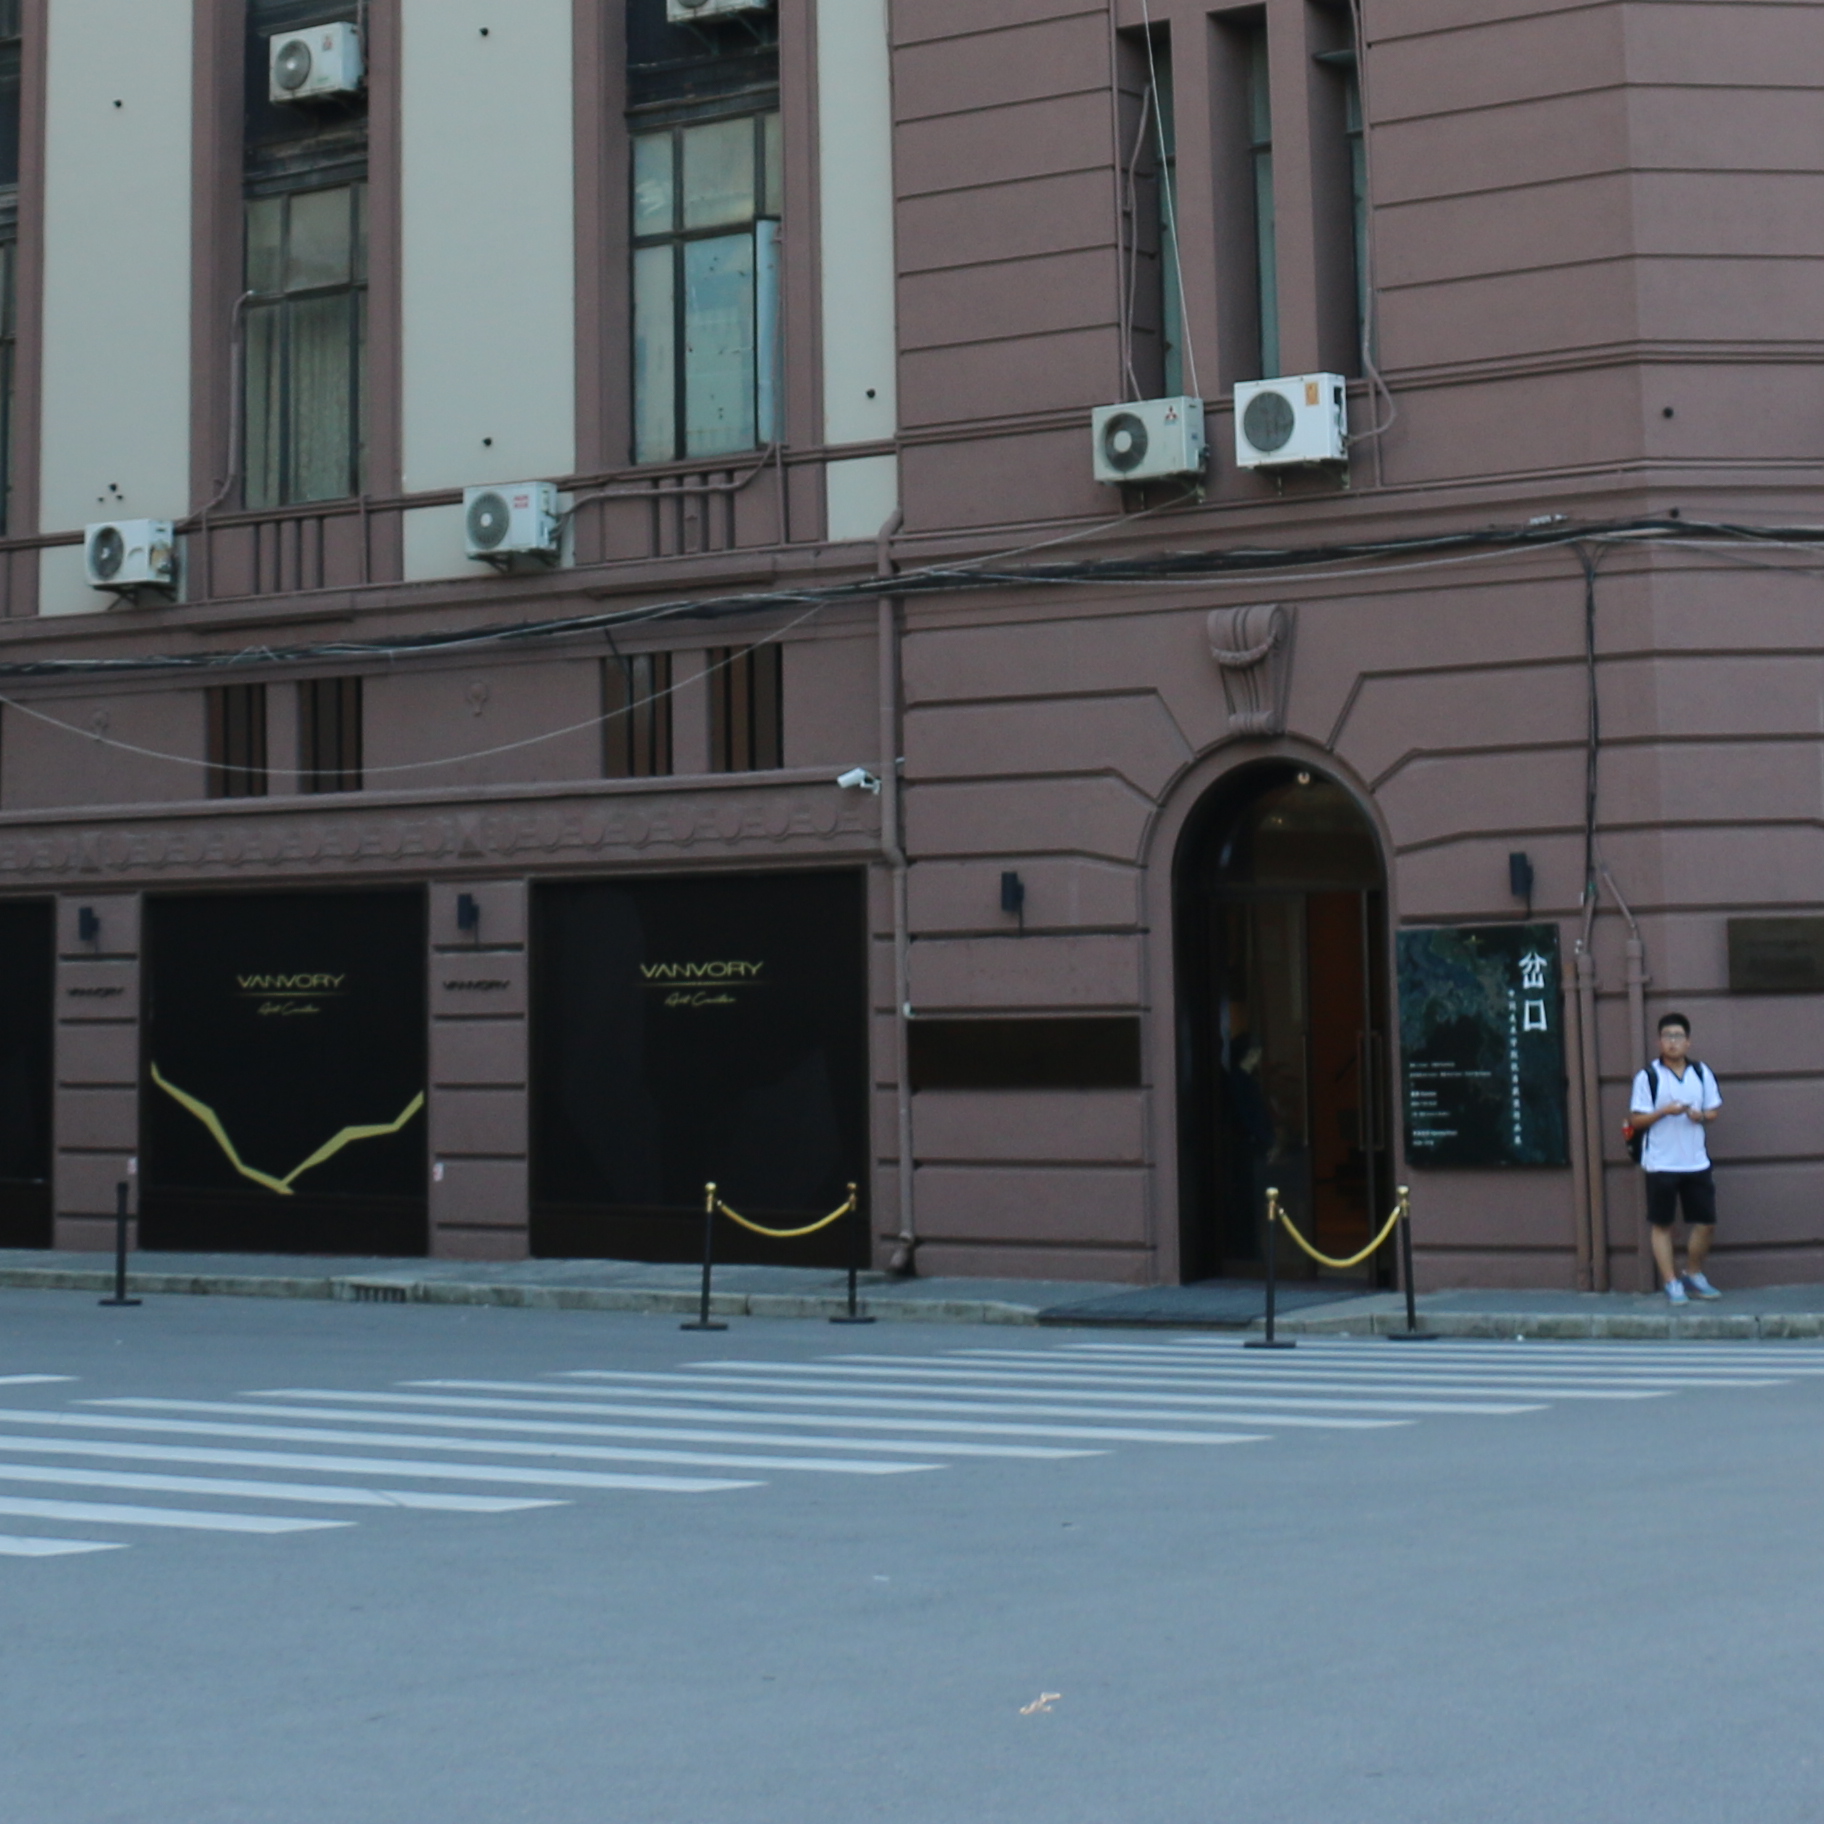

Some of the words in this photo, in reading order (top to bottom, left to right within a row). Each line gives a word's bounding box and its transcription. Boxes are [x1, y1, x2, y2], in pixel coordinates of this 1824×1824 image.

[640, 961, 764, 978] VANVORY
[236, 973, 344, 988] VANVORY
[1518, 950, 1548, 1032] 岔口
